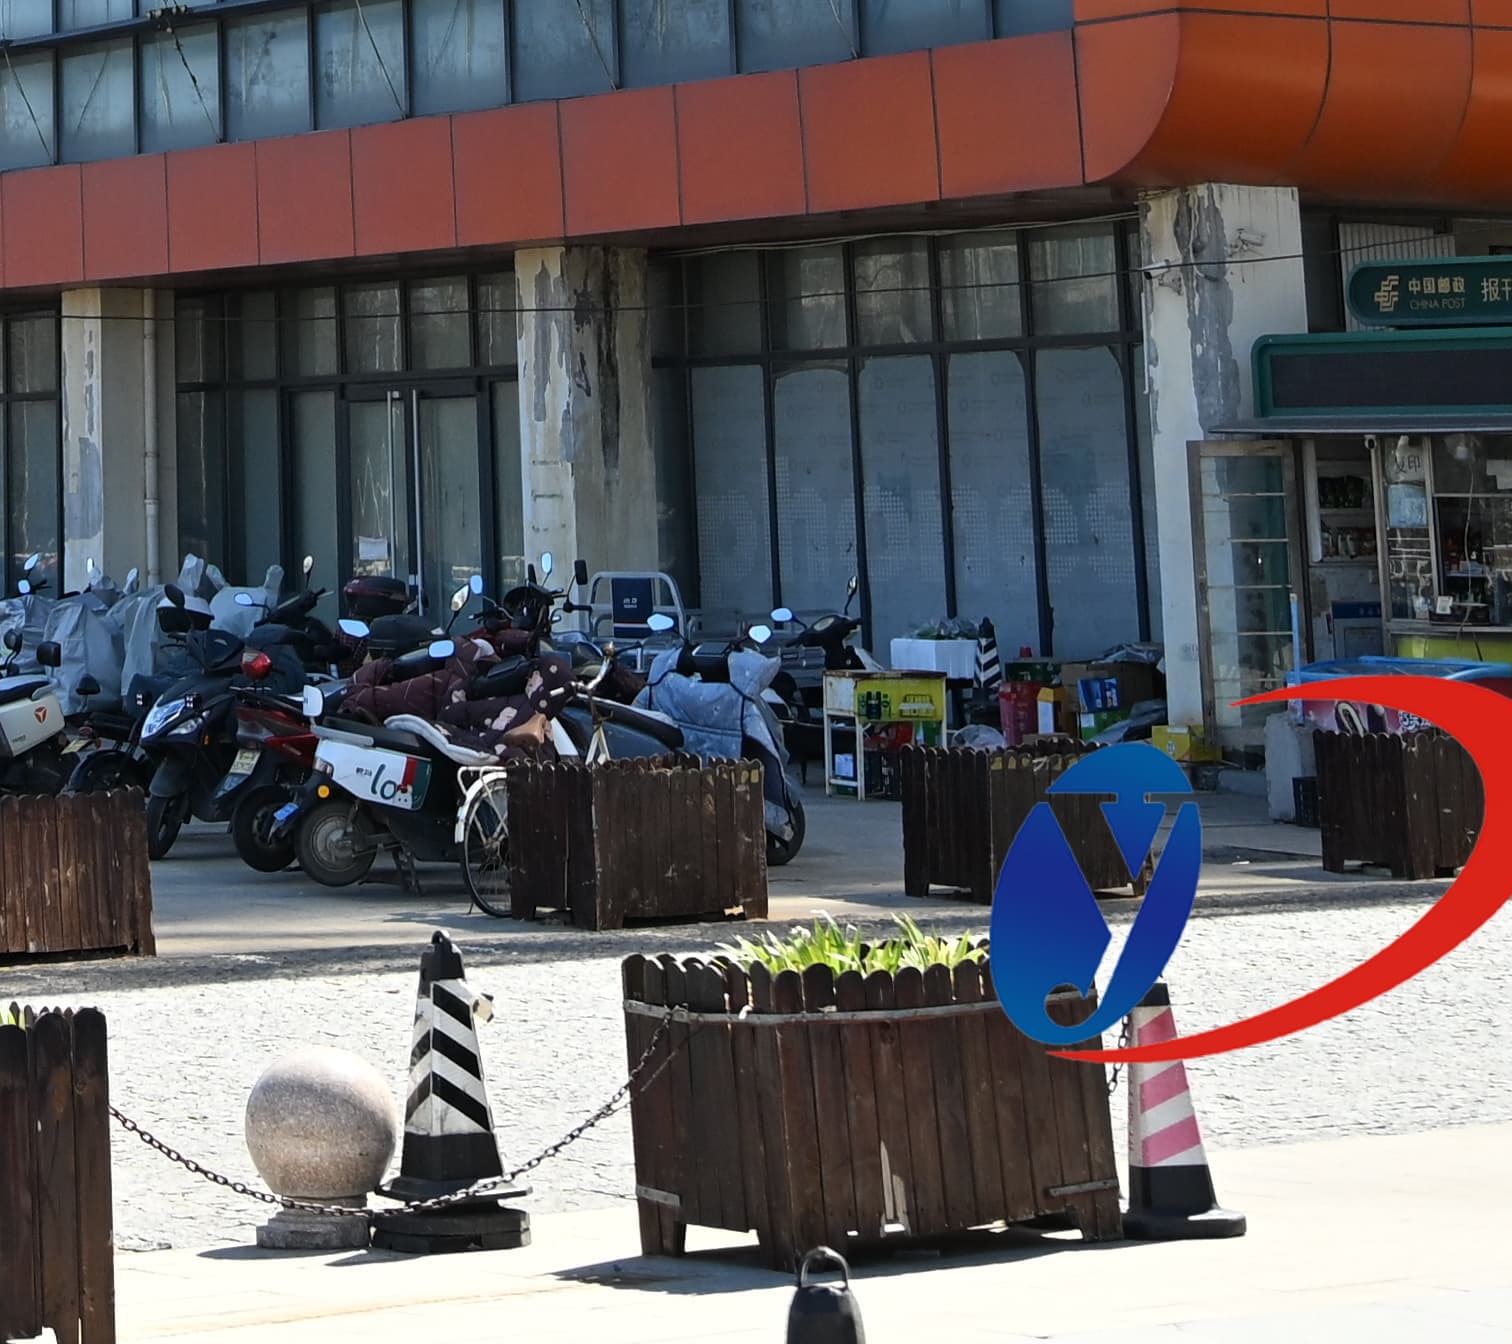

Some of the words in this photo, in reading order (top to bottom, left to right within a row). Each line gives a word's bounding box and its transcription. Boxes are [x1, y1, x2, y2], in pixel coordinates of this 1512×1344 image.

[1408, 276, 1466, 295] 中国邮政
[1409, 297, 1439, 310] CHINA
[1442, 296, 1466, 310] POST
